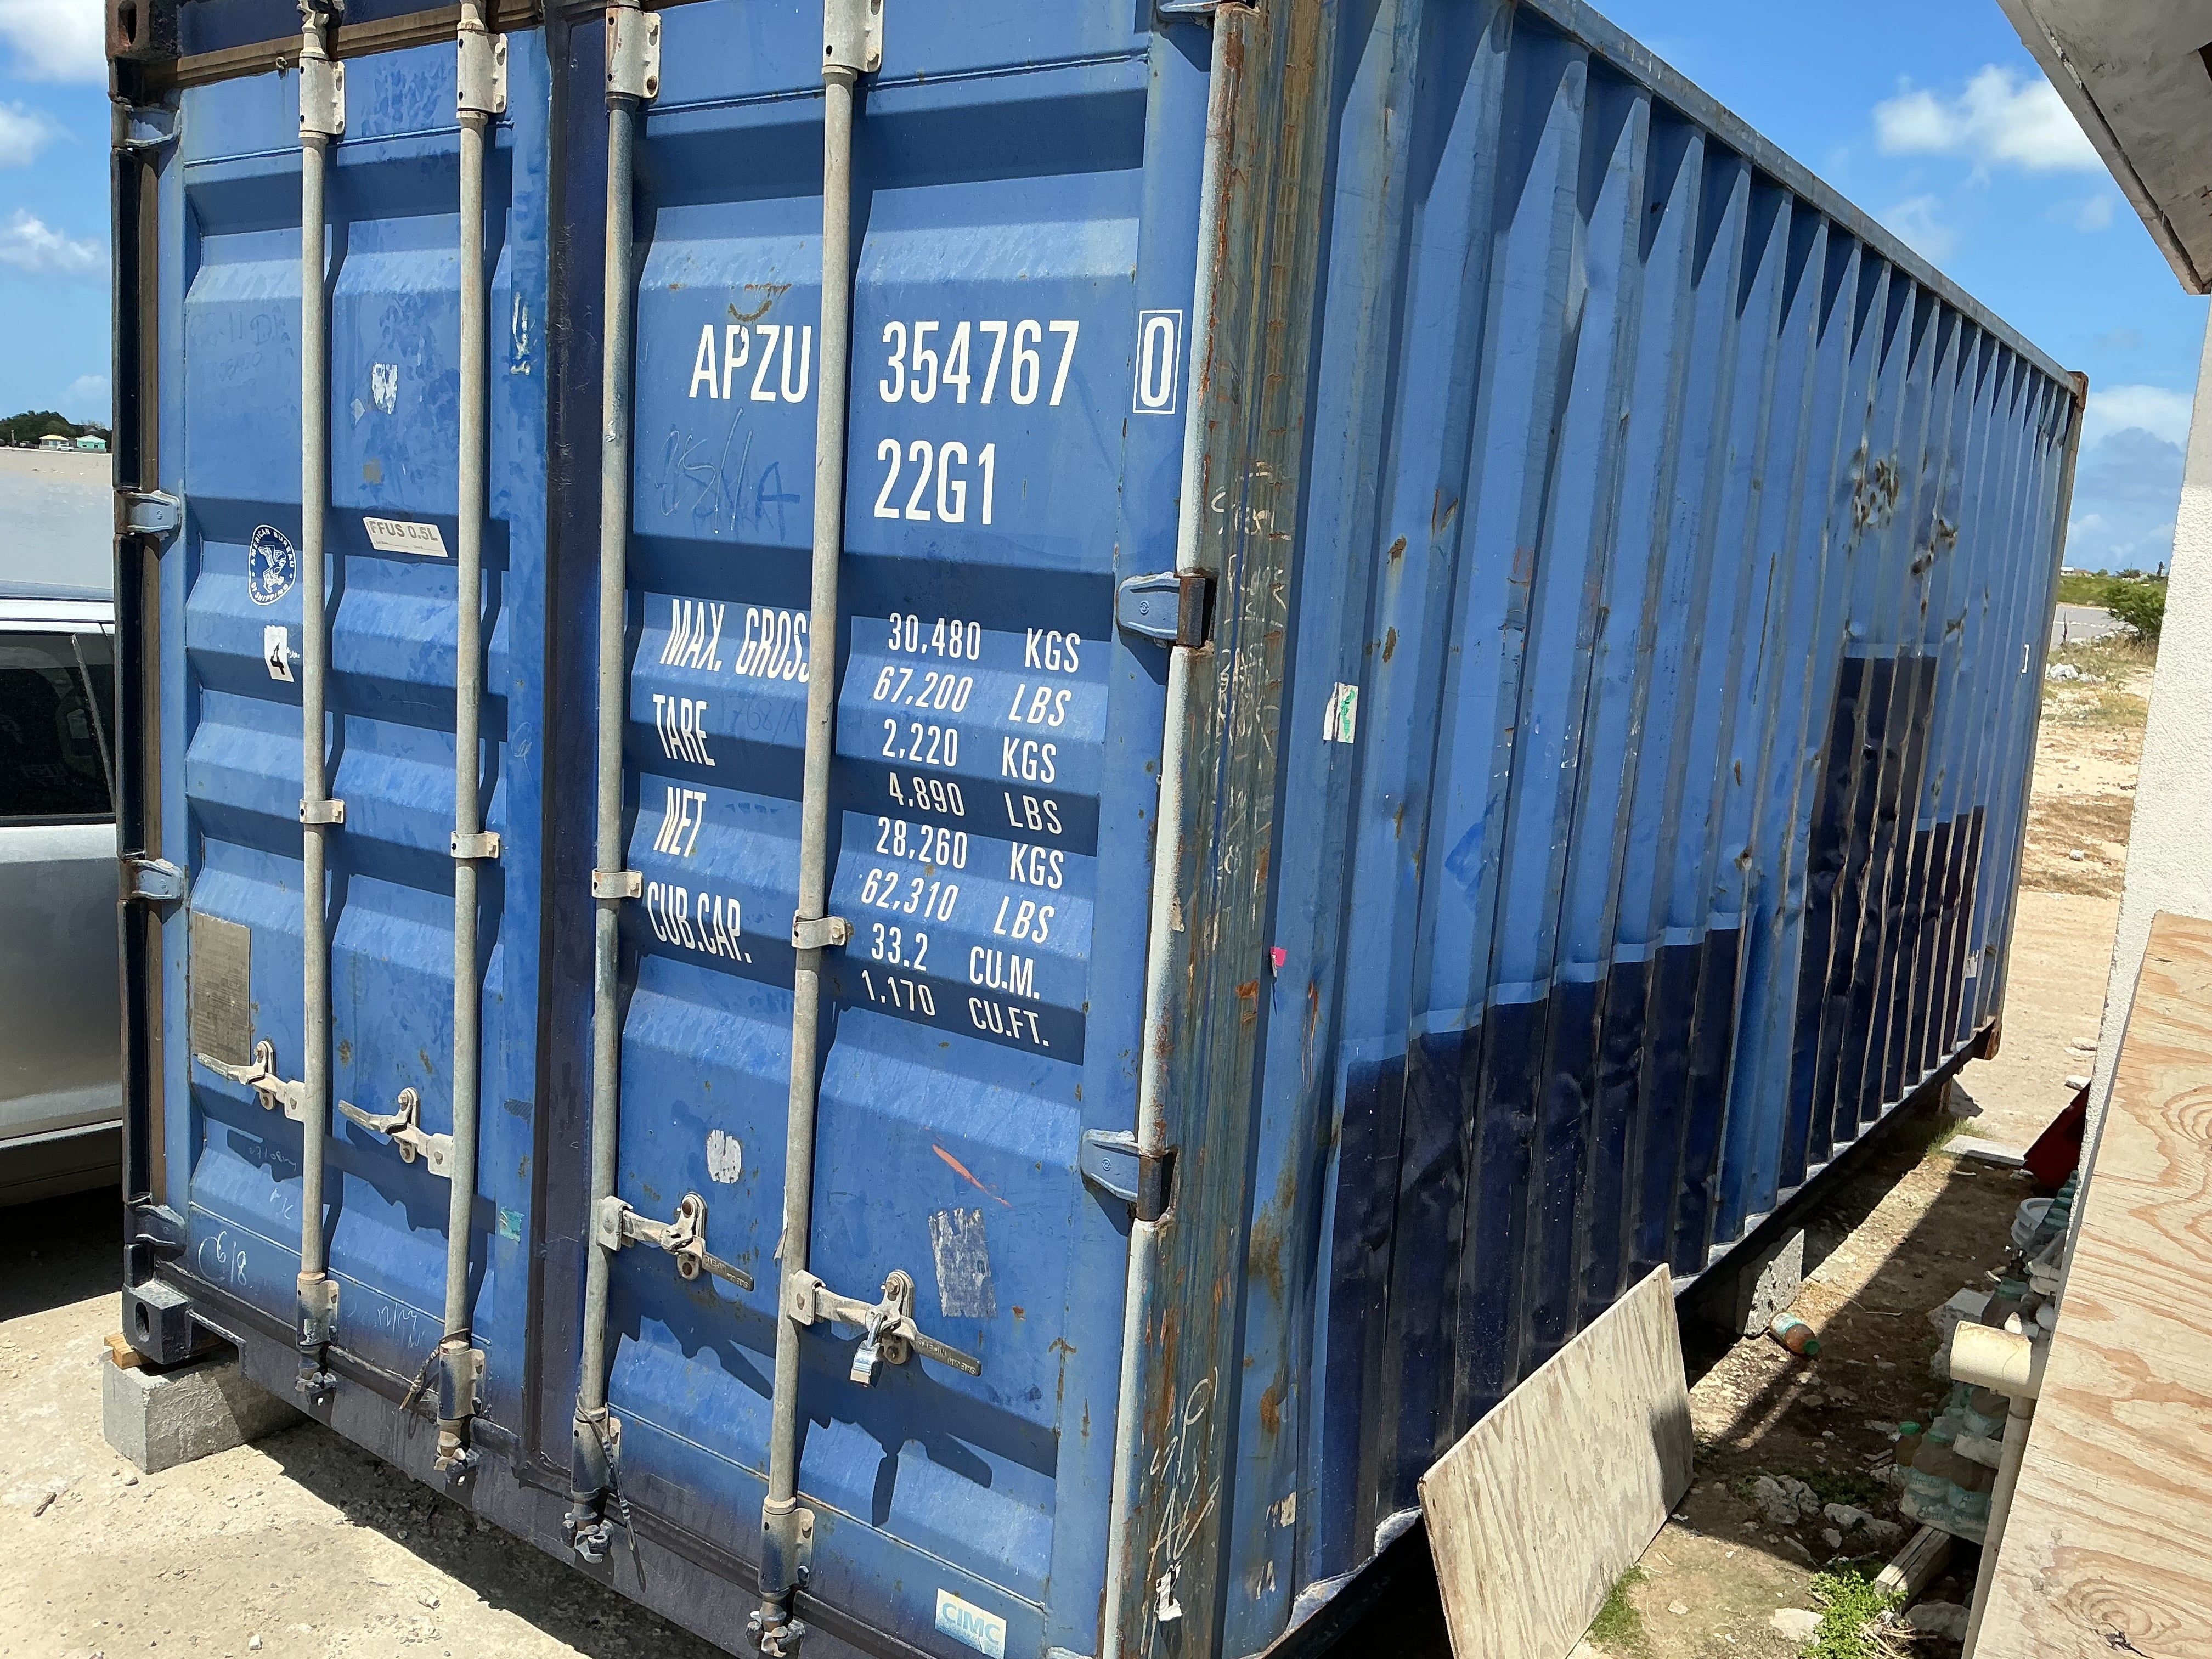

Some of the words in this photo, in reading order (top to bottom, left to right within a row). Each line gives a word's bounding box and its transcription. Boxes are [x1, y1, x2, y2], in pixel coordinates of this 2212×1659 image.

[689, 324, 812, 403] APZU
[879, 319, 1079, 406] 354767
[1140, 316, 1175, 410] 0
[873, 438, 996, 525] 22G1
[251, 528, 270, 566] AMERICAN
[273, 531, 294, 568] BUREAU
[408, 525, 438, 541] 0.5L
[251, 582, 258, 592] OF
[255, 583, 289, 602] SHIPPING
[658, 599, 725, 673] MAX.
[1024, 628, 1081, 673] KGS
[1008, 684, 1072, 727] LBS
[652, 693, 716, 766] TARE
[1001, 736, 1057, 784] KGS
[1003, 792, 1063, 834] LBS
[652, 786, 707, 859] NET
[1009, 841, 1064, 890] KGS
[647, 881, 753, 964] CUB.CAP.
[871, 923, 928, 972] 33.2
[969, 946, 1040, 1000] CU.M.
[992, 896, 1056, 944] LBS
[968, 997, 1050, 1047] CU.FT.
[941, 1602, 1000, 1645] CIMC
